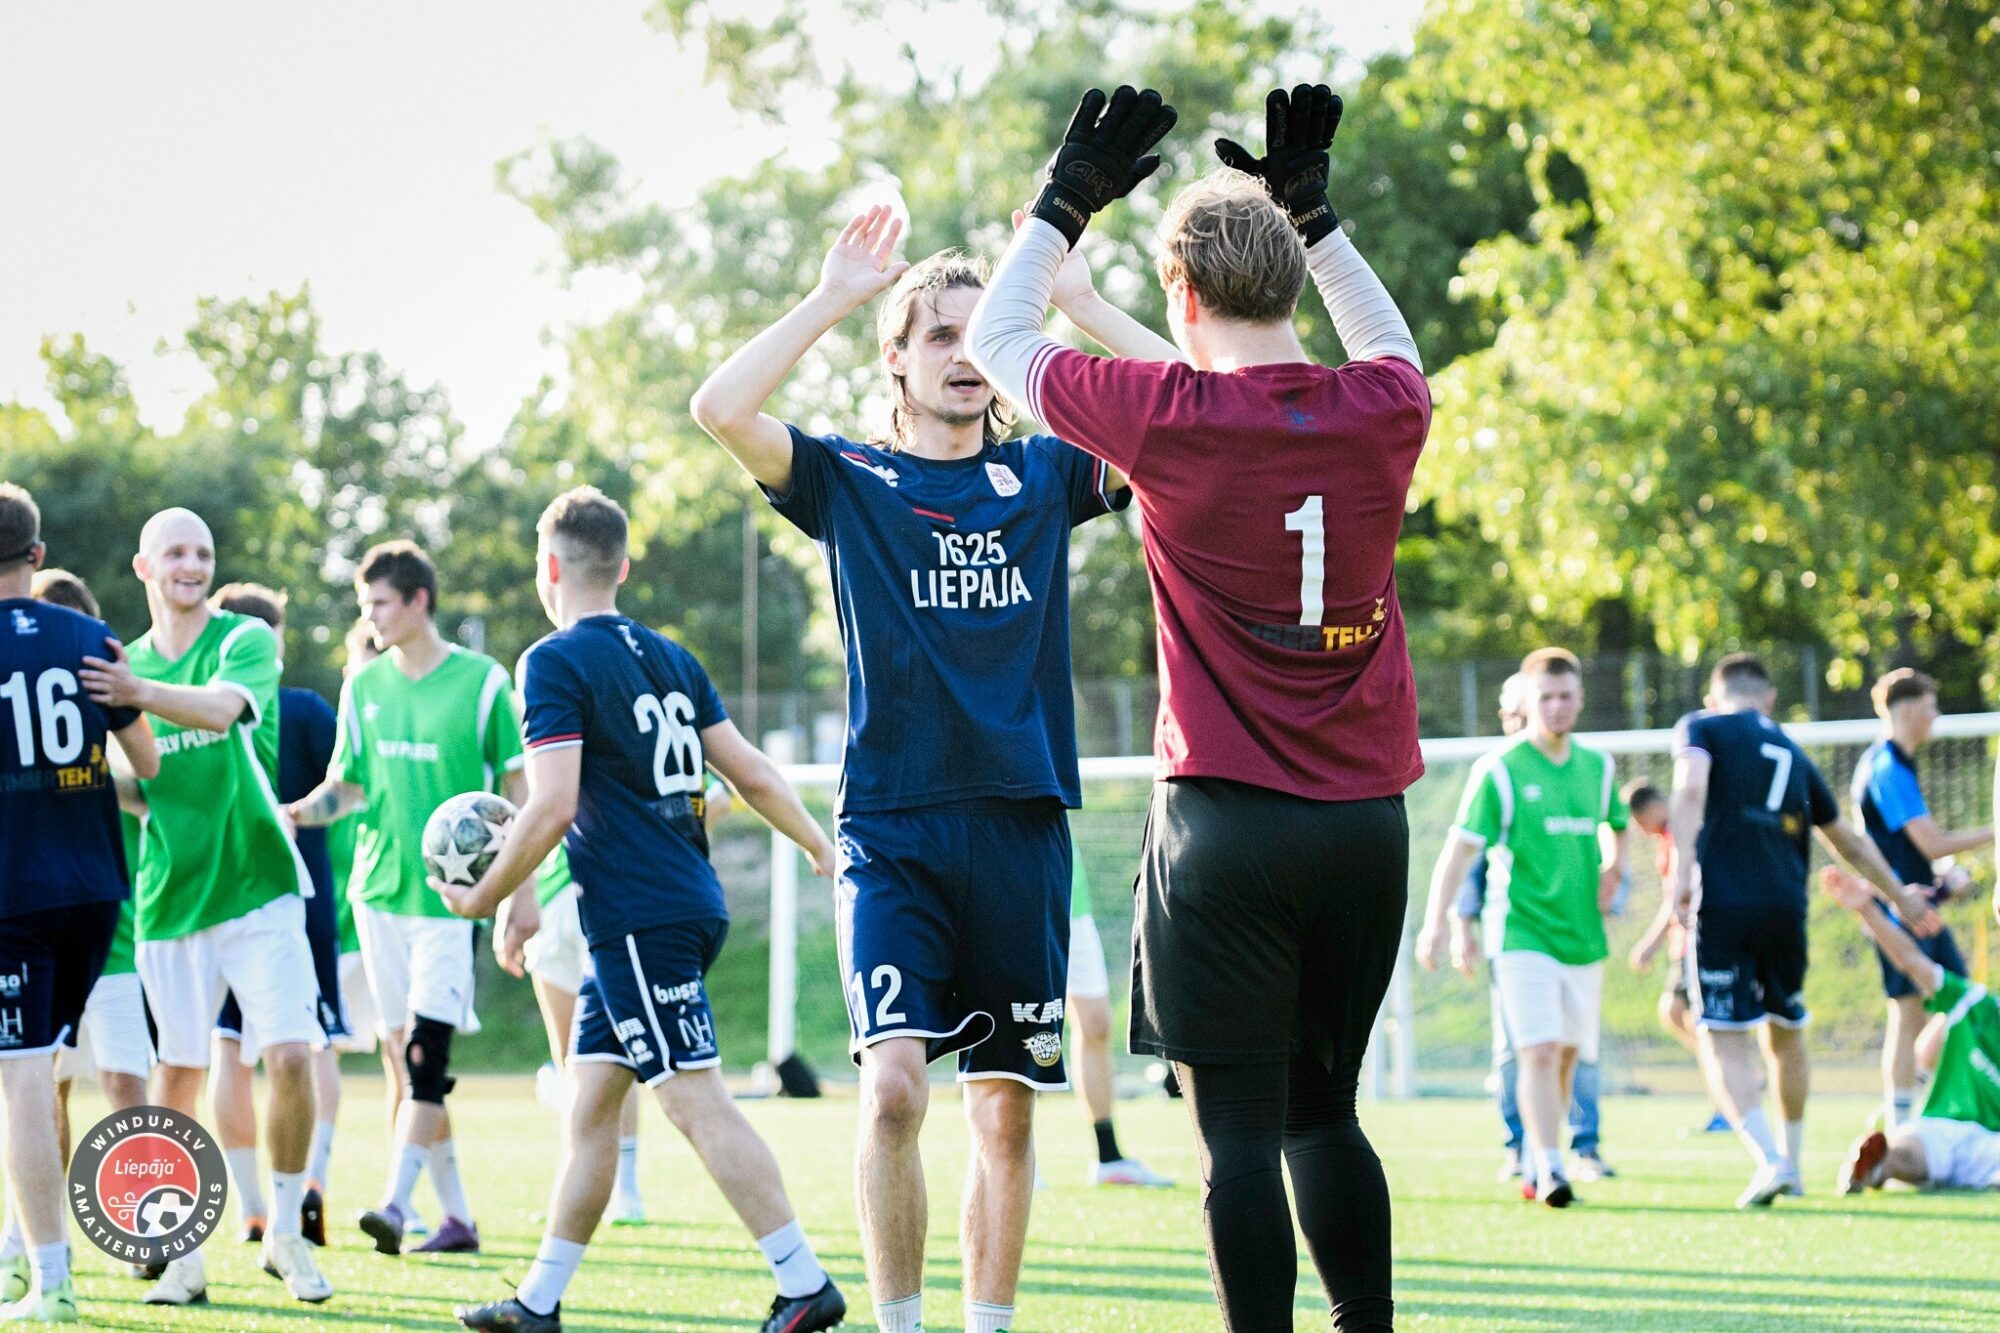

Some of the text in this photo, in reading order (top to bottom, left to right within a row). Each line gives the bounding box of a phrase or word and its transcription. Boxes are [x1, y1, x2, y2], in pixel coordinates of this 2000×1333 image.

[932, 530, 1007, 566] 1625
[1285, 496, 1325, 625] 1
[910, 567, 1032, 608] LIEPAJA
[0, 667, 84, 766] 16
[181, 728, 230, 750] PLU
[633, 691, 703, 796] 26
[1760, 743, 1792, 811] 7
[852, 964, 906, 1033] 12
